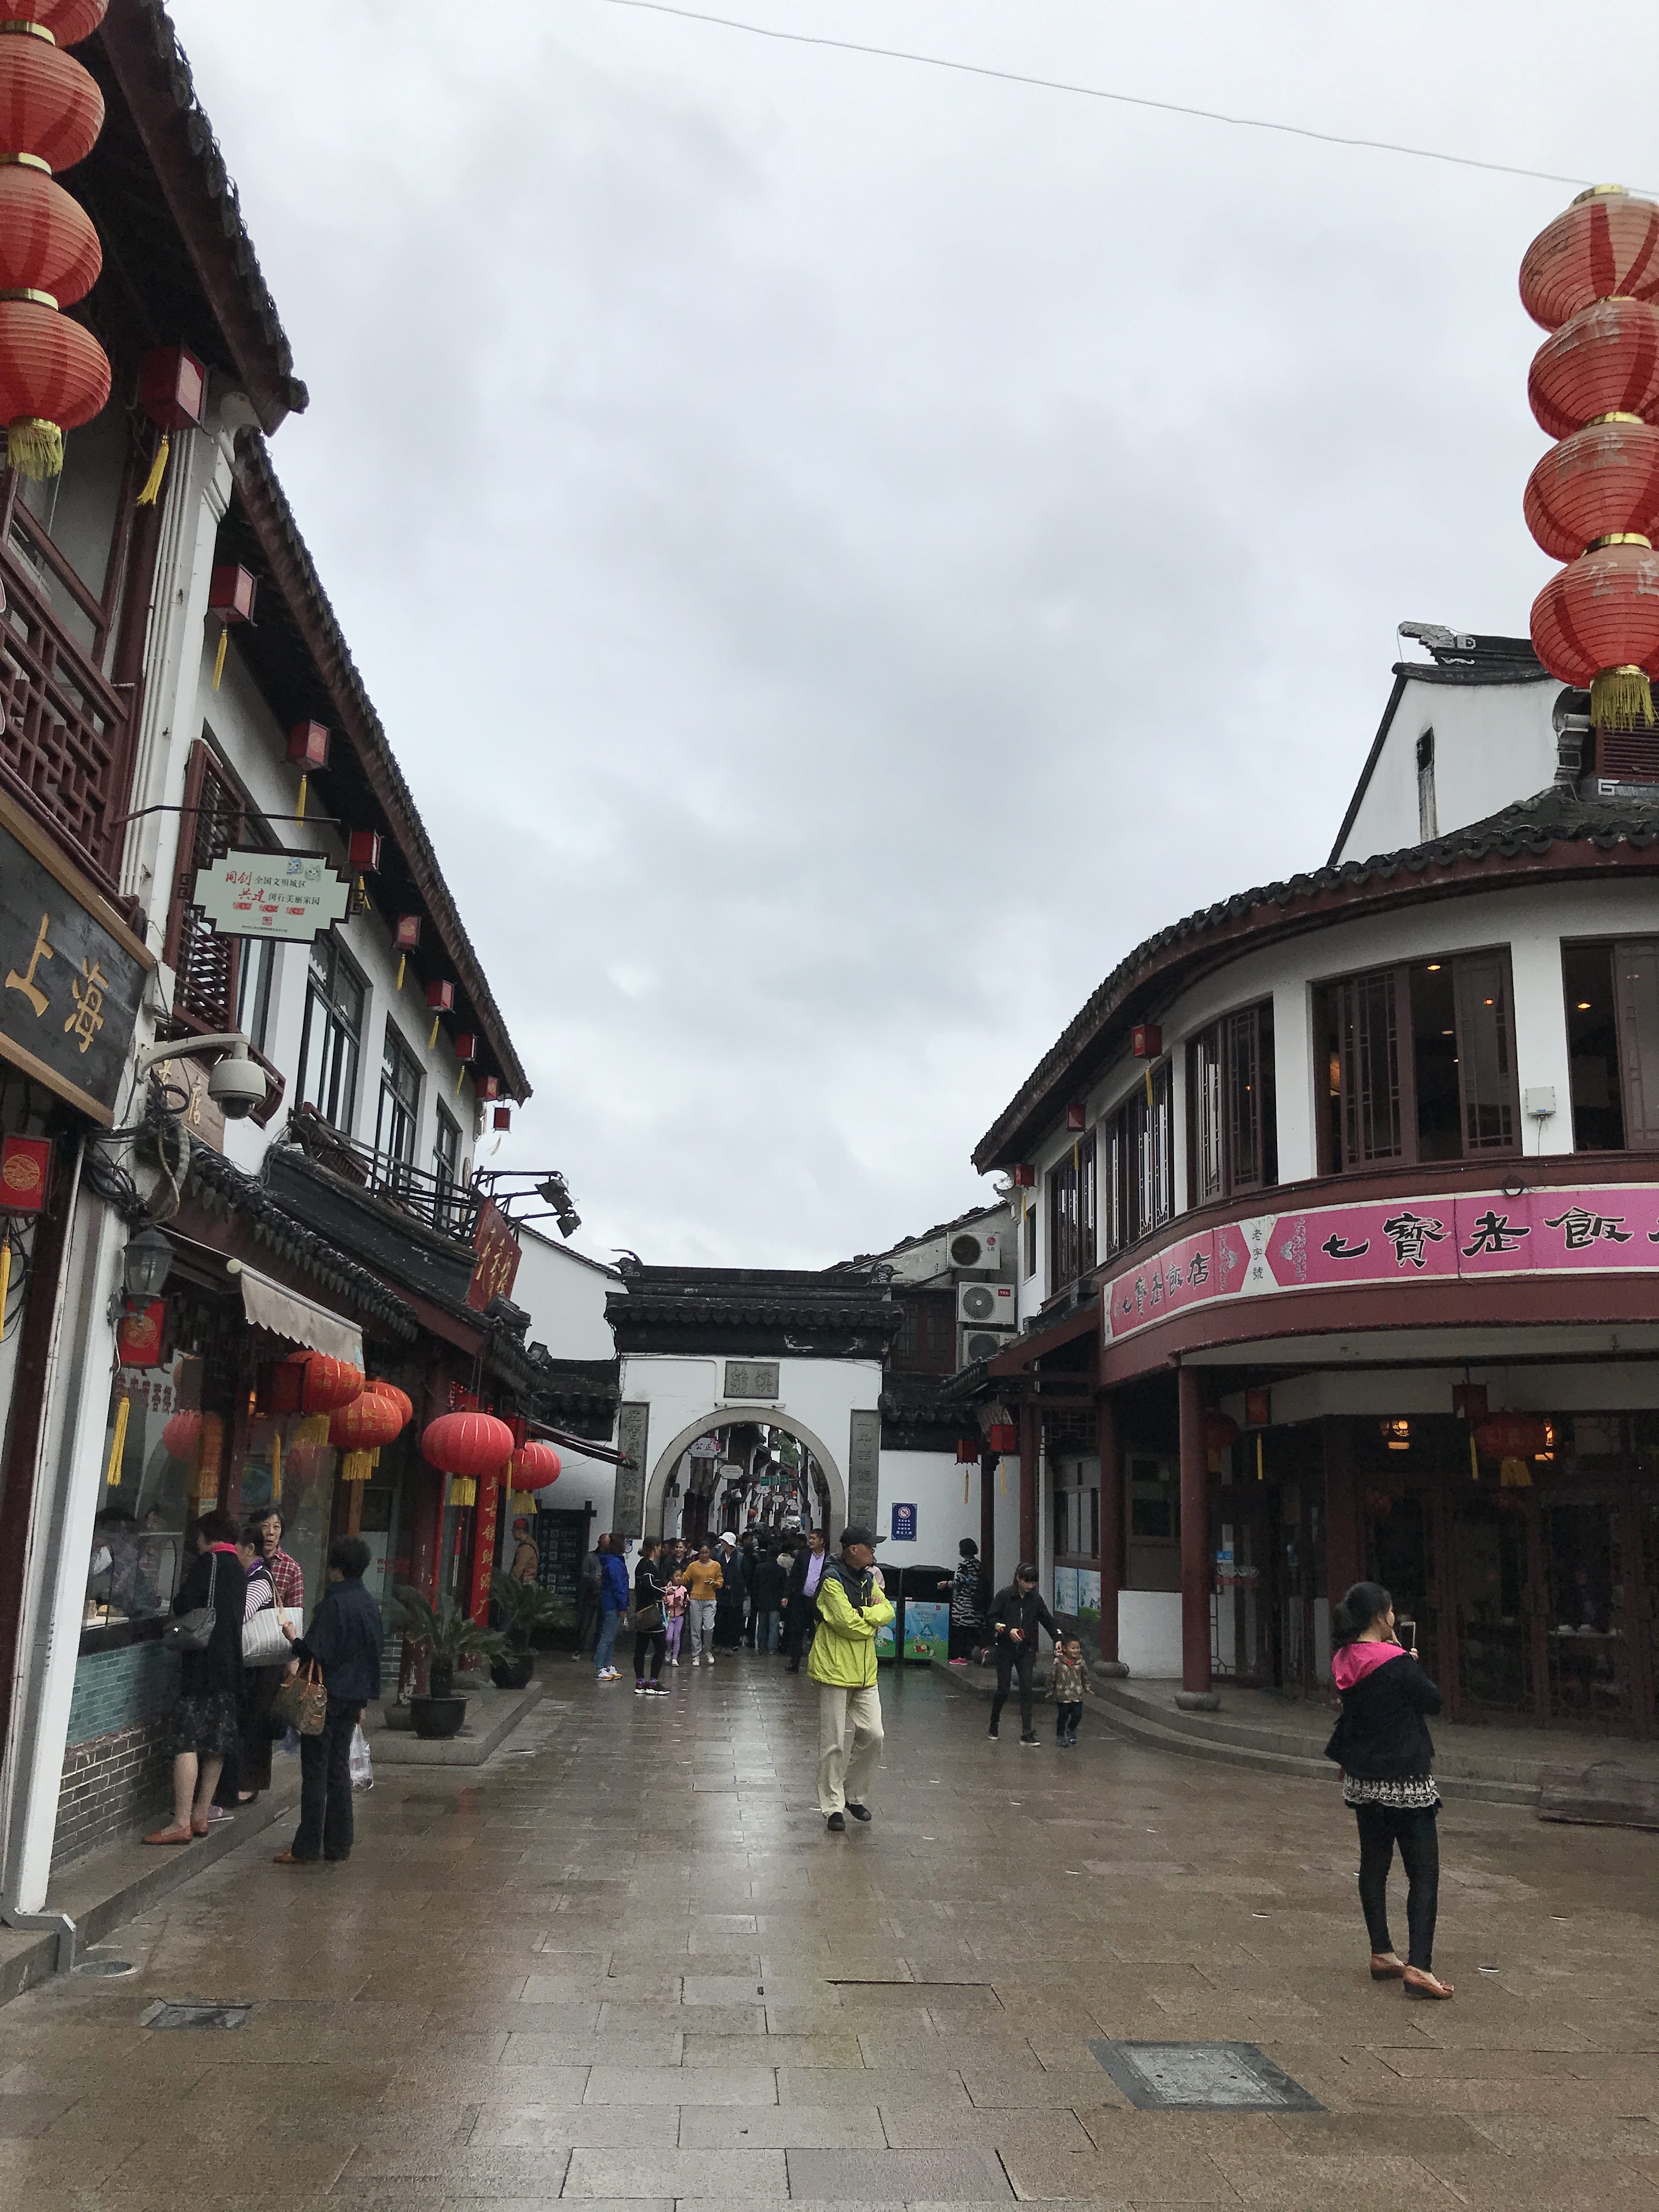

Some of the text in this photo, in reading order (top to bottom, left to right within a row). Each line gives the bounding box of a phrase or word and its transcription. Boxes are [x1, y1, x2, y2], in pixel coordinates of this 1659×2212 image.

[225, 871, 307, 888] 同创 全国文明城区
[238, 888, 266, 903] 共建
[268, 891, 321, 906] 闵行美丽家园
[4, 912, 110, 1053] 上海
[1251, 1228, 1263, 1280] 老字號
[1321, 1205, 1659, 1269] 七寶老飯
